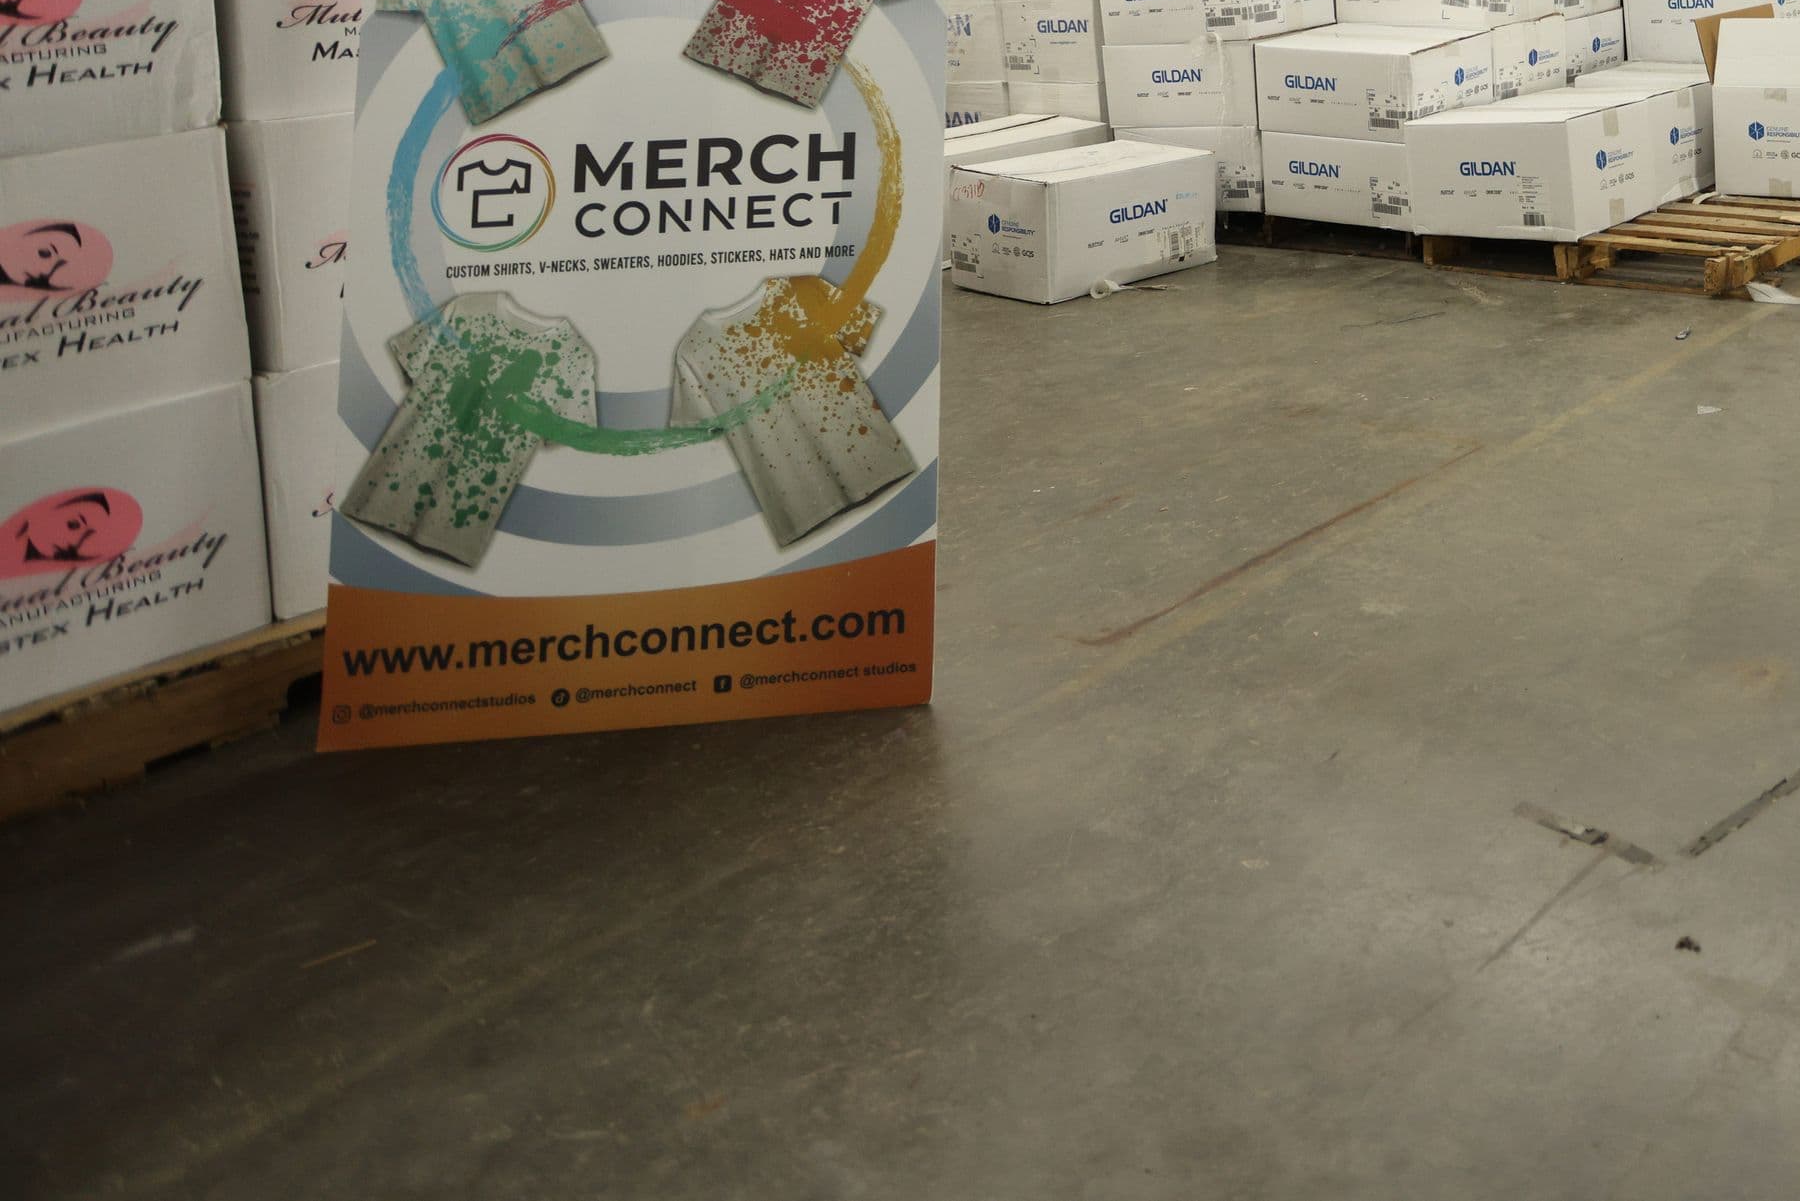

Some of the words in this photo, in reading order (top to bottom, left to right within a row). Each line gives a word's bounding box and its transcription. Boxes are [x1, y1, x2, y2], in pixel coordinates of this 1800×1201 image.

[275, 2, 363, 30] Mut
[1037, 17, 1088, 34] GILDAN
[21, 16, 179, 52] Beauty
[27, 61, 153, 87] HEALTH
[1152, 68, 1201, 84] GILDAN
[1285, 74, 1338, 91] GILDAN
[574, 132, 857, 193] MERCH
[1289, 160, 1340, 176] GILDAN
[1458, 160, 1515, 176] GILDAN
[575, 190, 853, 238] CONNECT
[1109, 201, 1168, 224] GILDAN
[446, 264, 491, 279] CUSTOM
[494, 261, 536, 276] SHIRTS,
[539, 259, 590, 274] V-NECKS,
[594, 255, 654, 271] SWEATERS,
[657, 252, 707, 268] HOODIES,
[710, 250, 766, 265] STICKERS,
[770, 248, 796, 261] HATS
[800, 247, 822, 259] AND
[825, 245, 855, 259] MORE
[53, 275, 204, 318] Beauty
[57, 320, 179, 357] HEALTH
[80, 532, 228, 588] Beauty
[86, 578, 204, 627] HEALTH
[343, 608, 905, 677] www.merchconnect.com
[740, 667, 860, 690] @merchconnect
[864, 661, 917, 678] studios
[576, 679, 697, 702] @merchconnect
[359, 692, 536, 719] @merchconnectstudios
